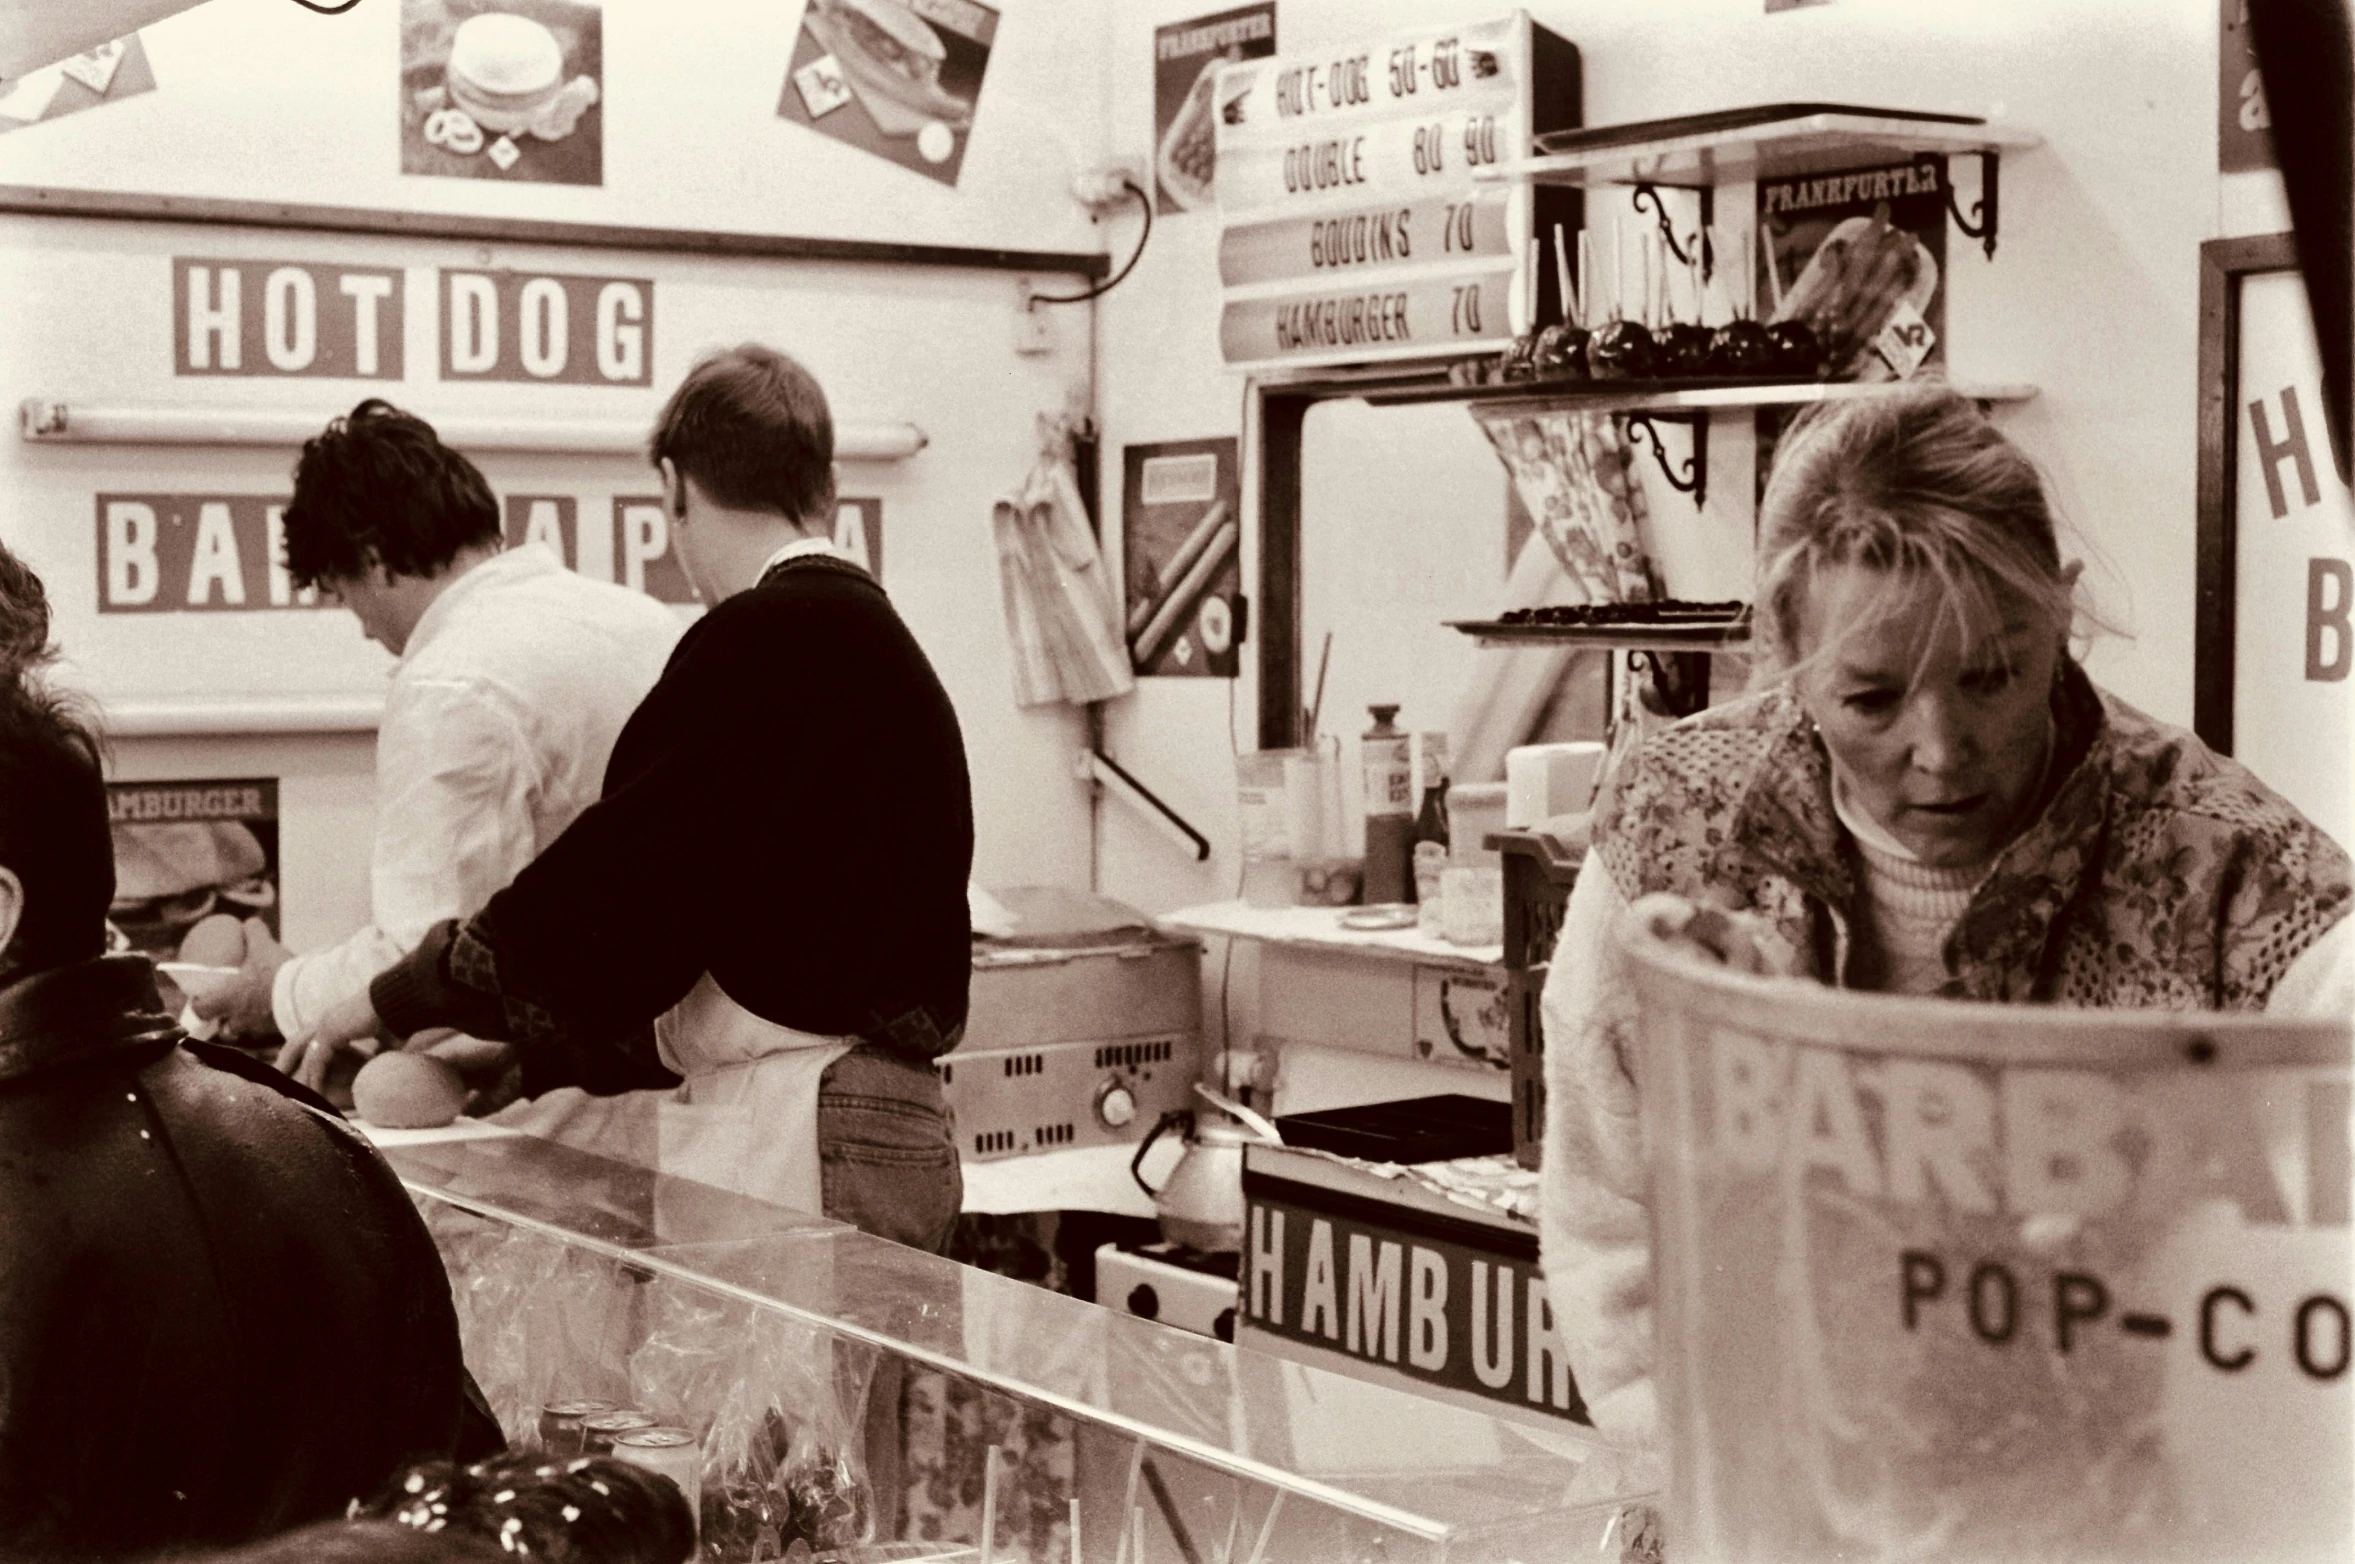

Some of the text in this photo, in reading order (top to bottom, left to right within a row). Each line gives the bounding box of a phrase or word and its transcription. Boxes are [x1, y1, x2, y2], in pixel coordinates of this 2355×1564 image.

[1277, 55, 1369, 118] HOT-DOG
[1284, 136, 1366, 192] DOUBLE
[1464, 115, 1495, 166] 90
[1311, 203, 1474, 267] BOUDINS 70
[187, 266, 644, 381] HOT DOG
[1277, 283, 1482, 351] HAMBURGER 70
[1901, 1250, 2353, 1381] POP-CO
